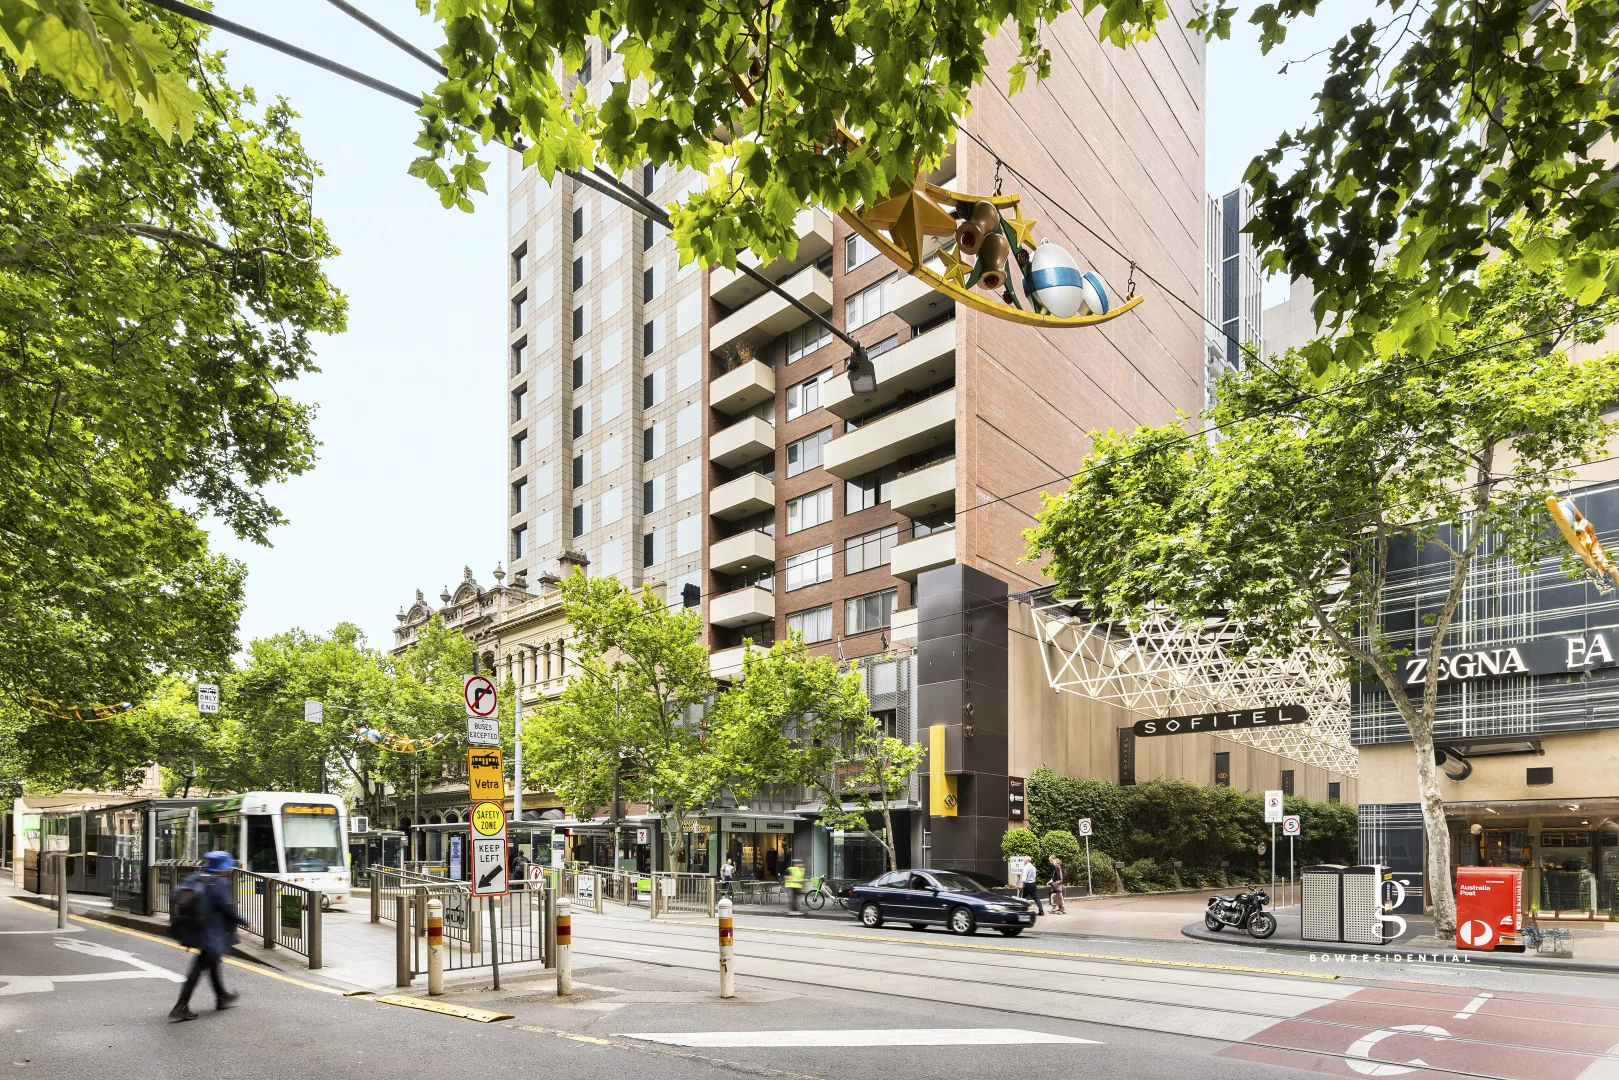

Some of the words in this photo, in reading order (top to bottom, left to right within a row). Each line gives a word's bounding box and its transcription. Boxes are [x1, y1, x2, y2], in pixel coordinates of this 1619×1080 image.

[200, 694, 216, 702] ONLY
[474, 722, 493, 731] BUSES
[1144, 709, 1293, 735] SOFITEL
[469, 731, 498, 740] EXCEPTED
[474, 779, 500, 789] Vetra
[476, 810, 500, 820] SAFETY
[480, 821, 497, 830] ZONE
[1288, 821, 1295, 830] 5
[478, 844, 501, 853] KEEP
[480, 854, 500, 863] LEFT
[1459, 884, 1491, 892] Australia
